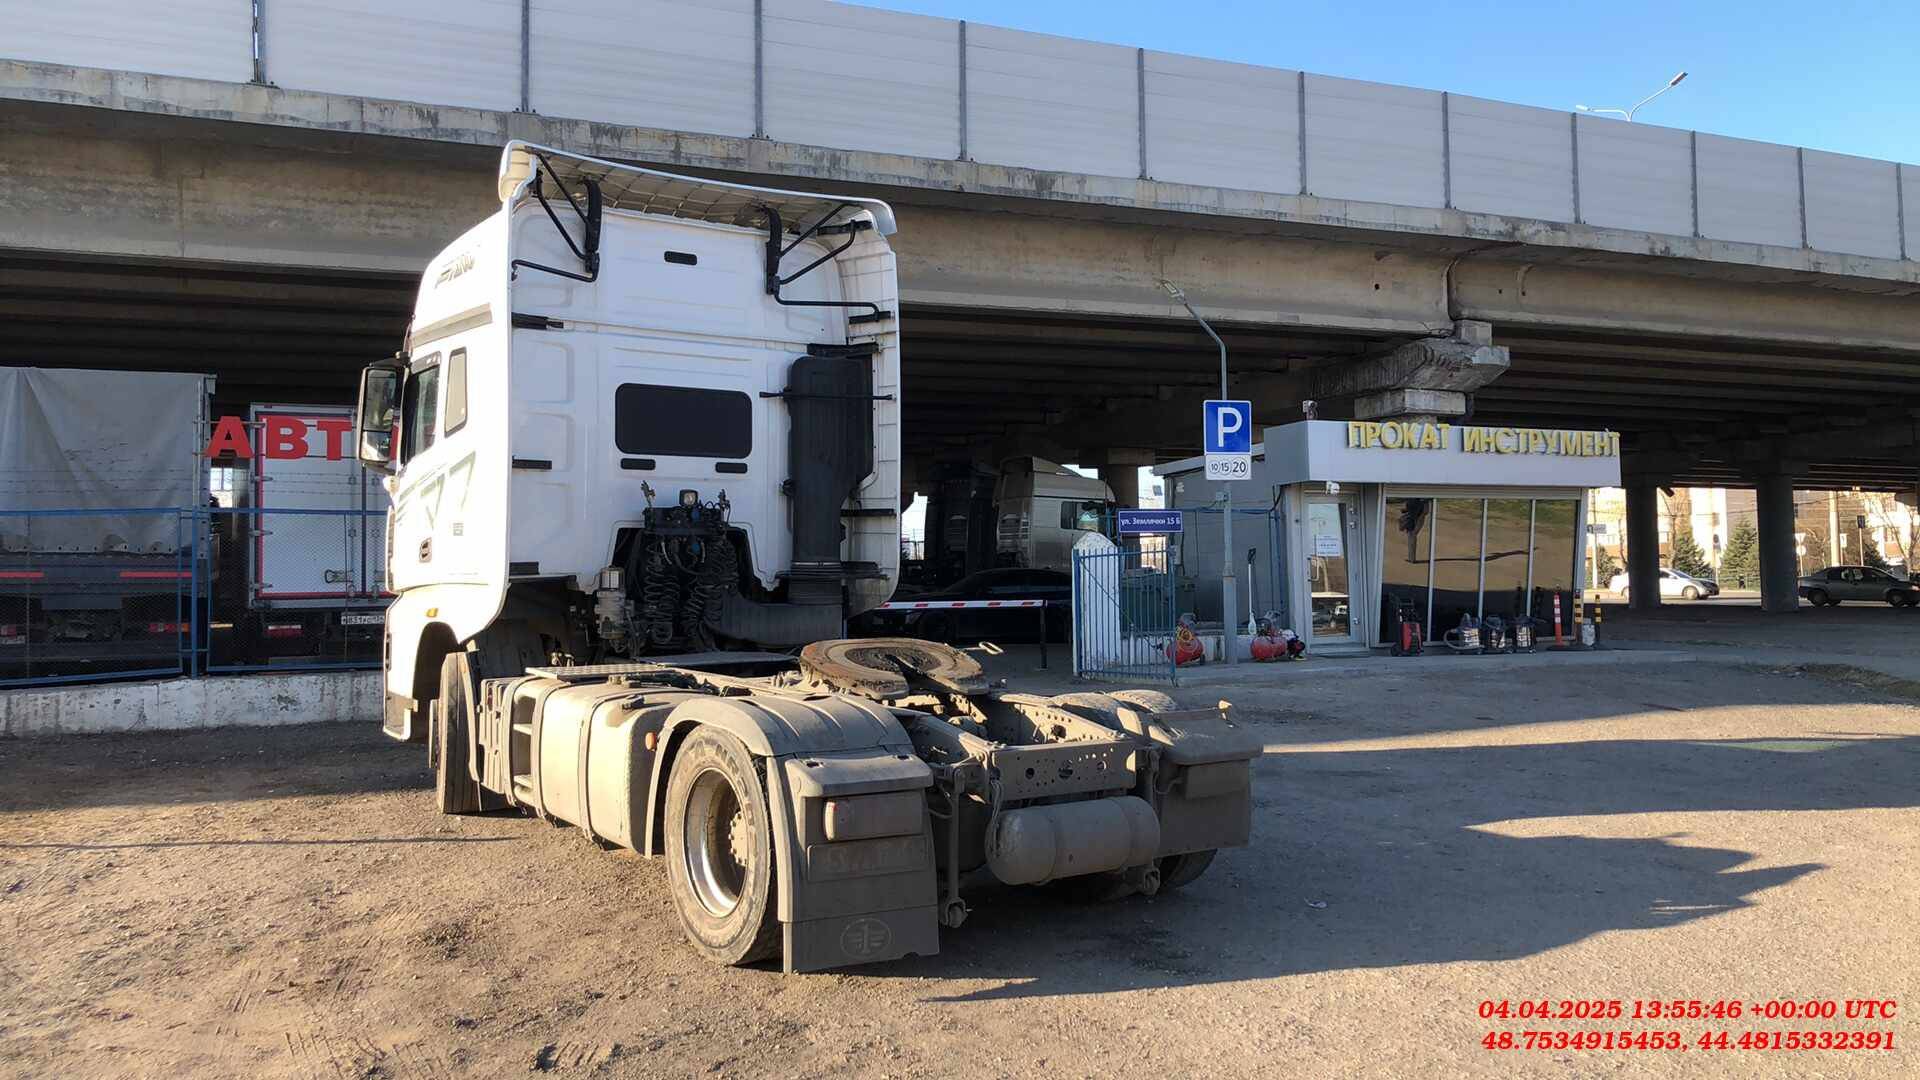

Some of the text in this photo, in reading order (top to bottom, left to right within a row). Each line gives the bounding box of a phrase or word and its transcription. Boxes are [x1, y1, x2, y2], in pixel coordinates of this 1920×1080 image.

[1217, 407, 1243, 448] P
[1347, 421, 1620, 457] ПРОКАТ ИНСТРУМЕНТ
[1210, 463, 1219, 472] 10
[1220, 462, 1230, 473] 15
[1232, 461, 1247, 473] 20
[1166, 517, 1175, 525] 15
